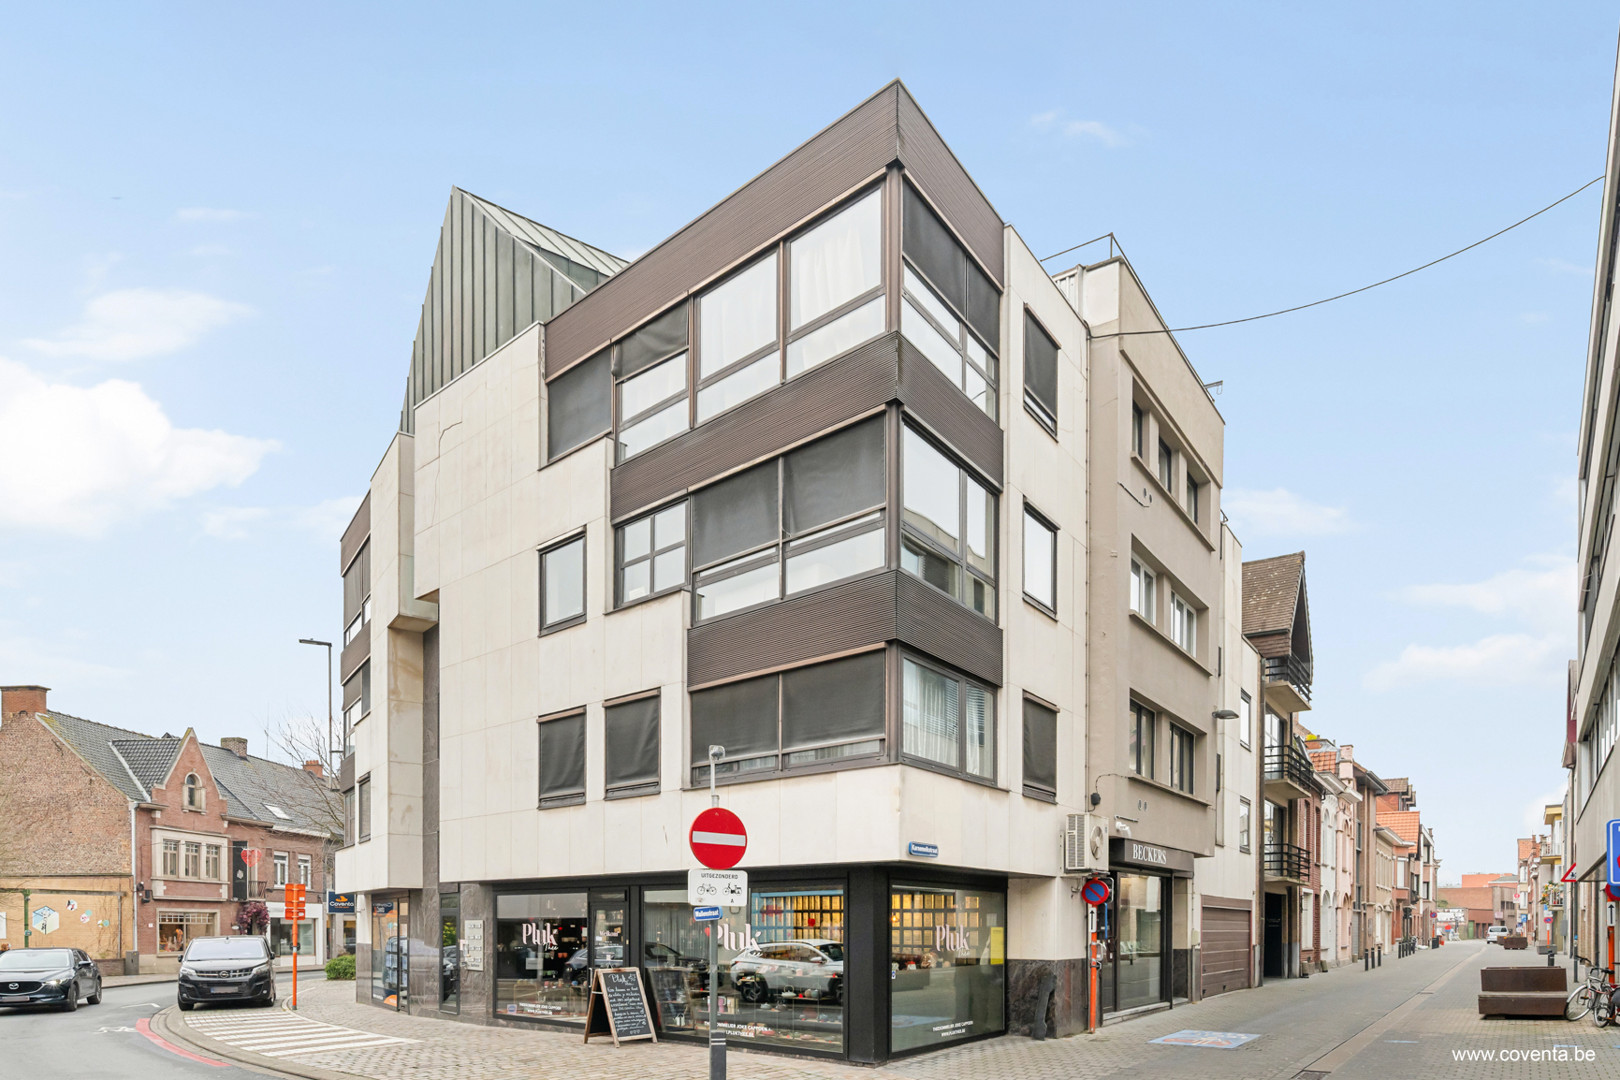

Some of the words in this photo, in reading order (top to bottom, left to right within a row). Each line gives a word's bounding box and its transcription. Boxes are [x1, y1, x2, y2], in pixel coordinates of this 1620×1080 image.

[1133, 844, 1167, 864] BECKERS
[700, 872, 739, 880] UITGEZONDERD
[522, 922, 558, 946] Pluk
[936, 924, 970, 952] Pluk
